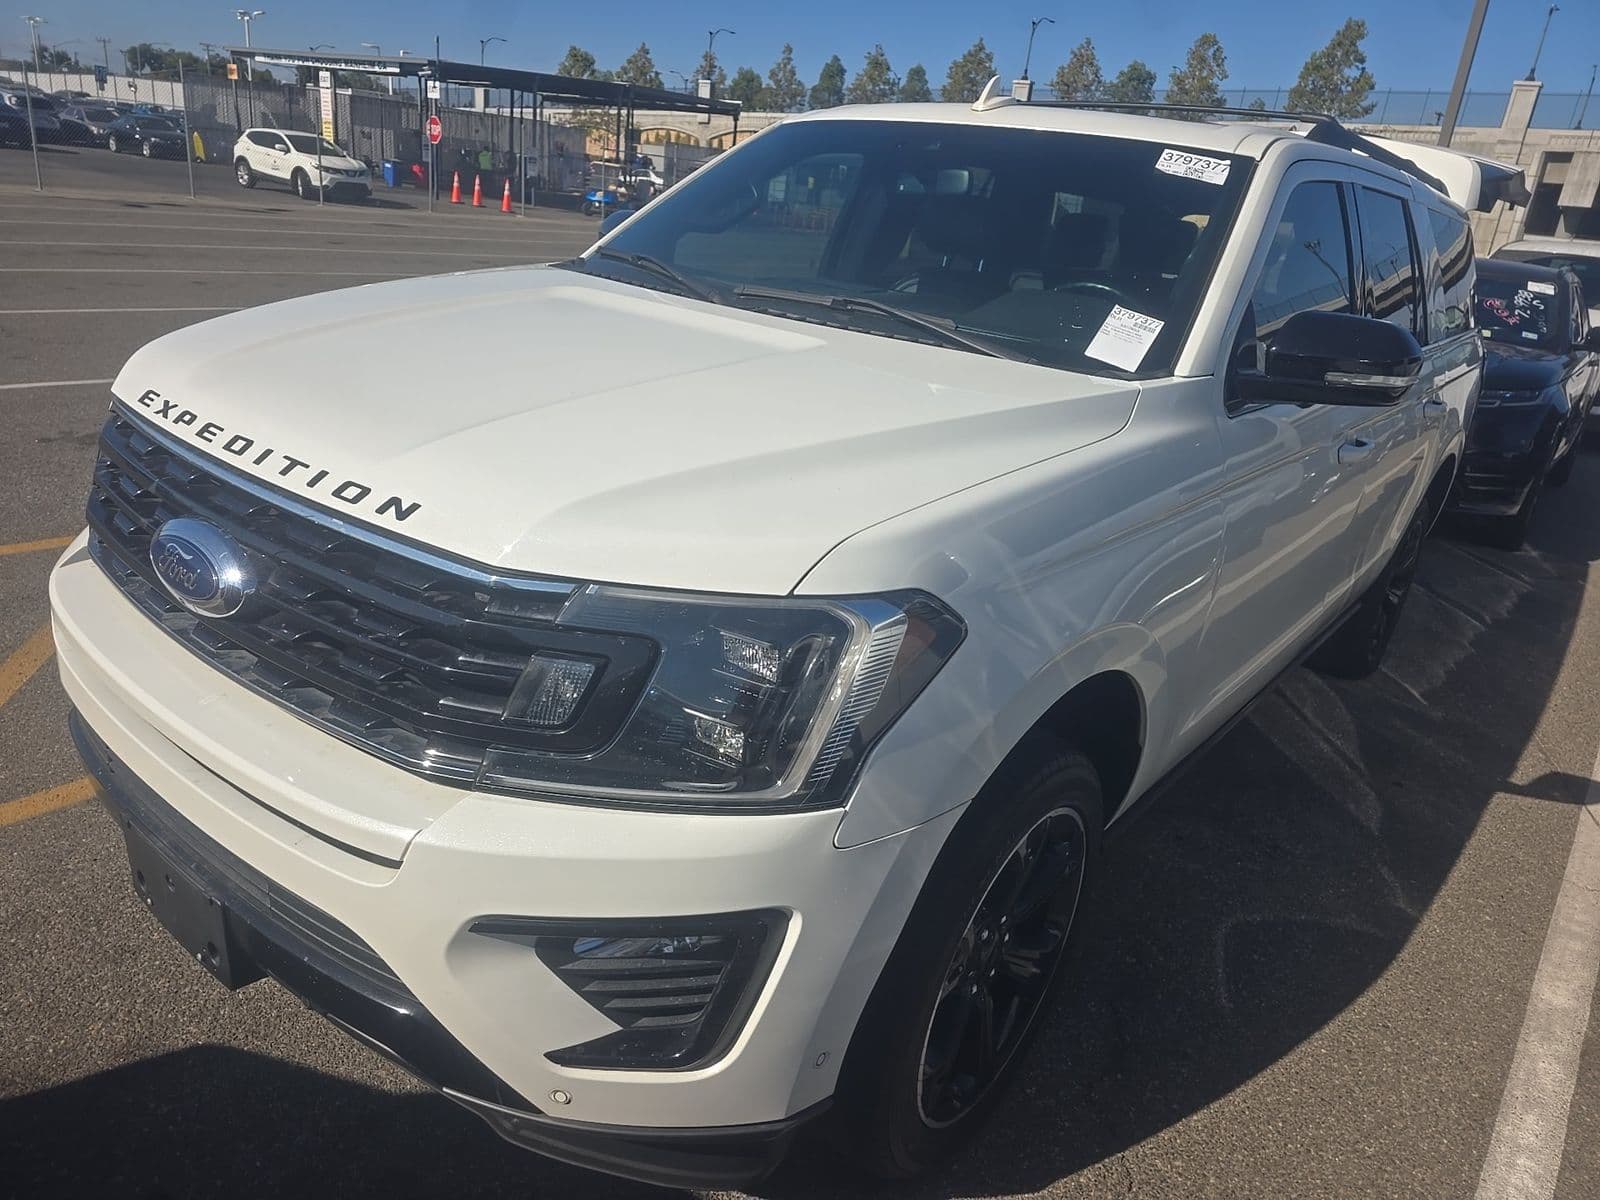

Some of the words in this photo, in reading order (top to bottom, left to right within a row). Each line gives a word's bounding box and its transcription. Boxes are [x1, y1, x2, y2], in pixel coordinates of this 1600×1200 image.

[1163, 151, 1231, 173] 3797377
[1113, 307, 1163, 329] 3797377
[137, 389, 422, 522] EXPEDITION
